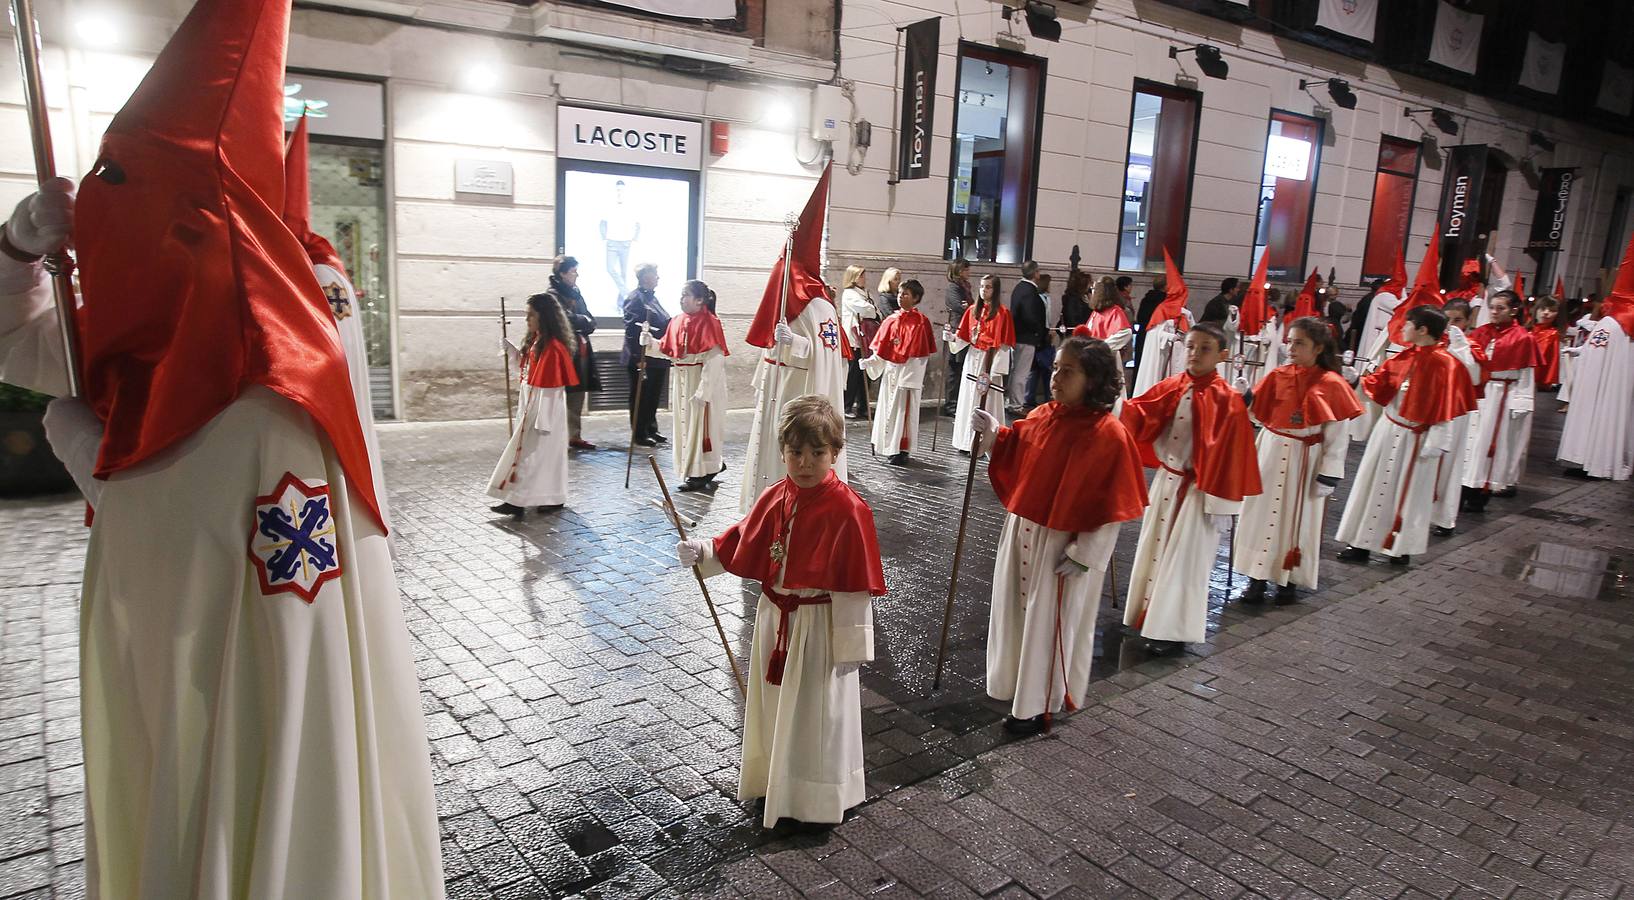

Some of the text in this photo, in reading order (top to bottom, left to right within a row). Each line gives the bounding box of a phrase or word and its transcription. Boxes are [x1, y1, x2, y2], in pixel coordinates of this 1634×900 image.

[575, 124, 686, 154] LACOSTE
[910, 70, 925, 168] hoyman
[1444, 175, 1468, 237] hoyman
